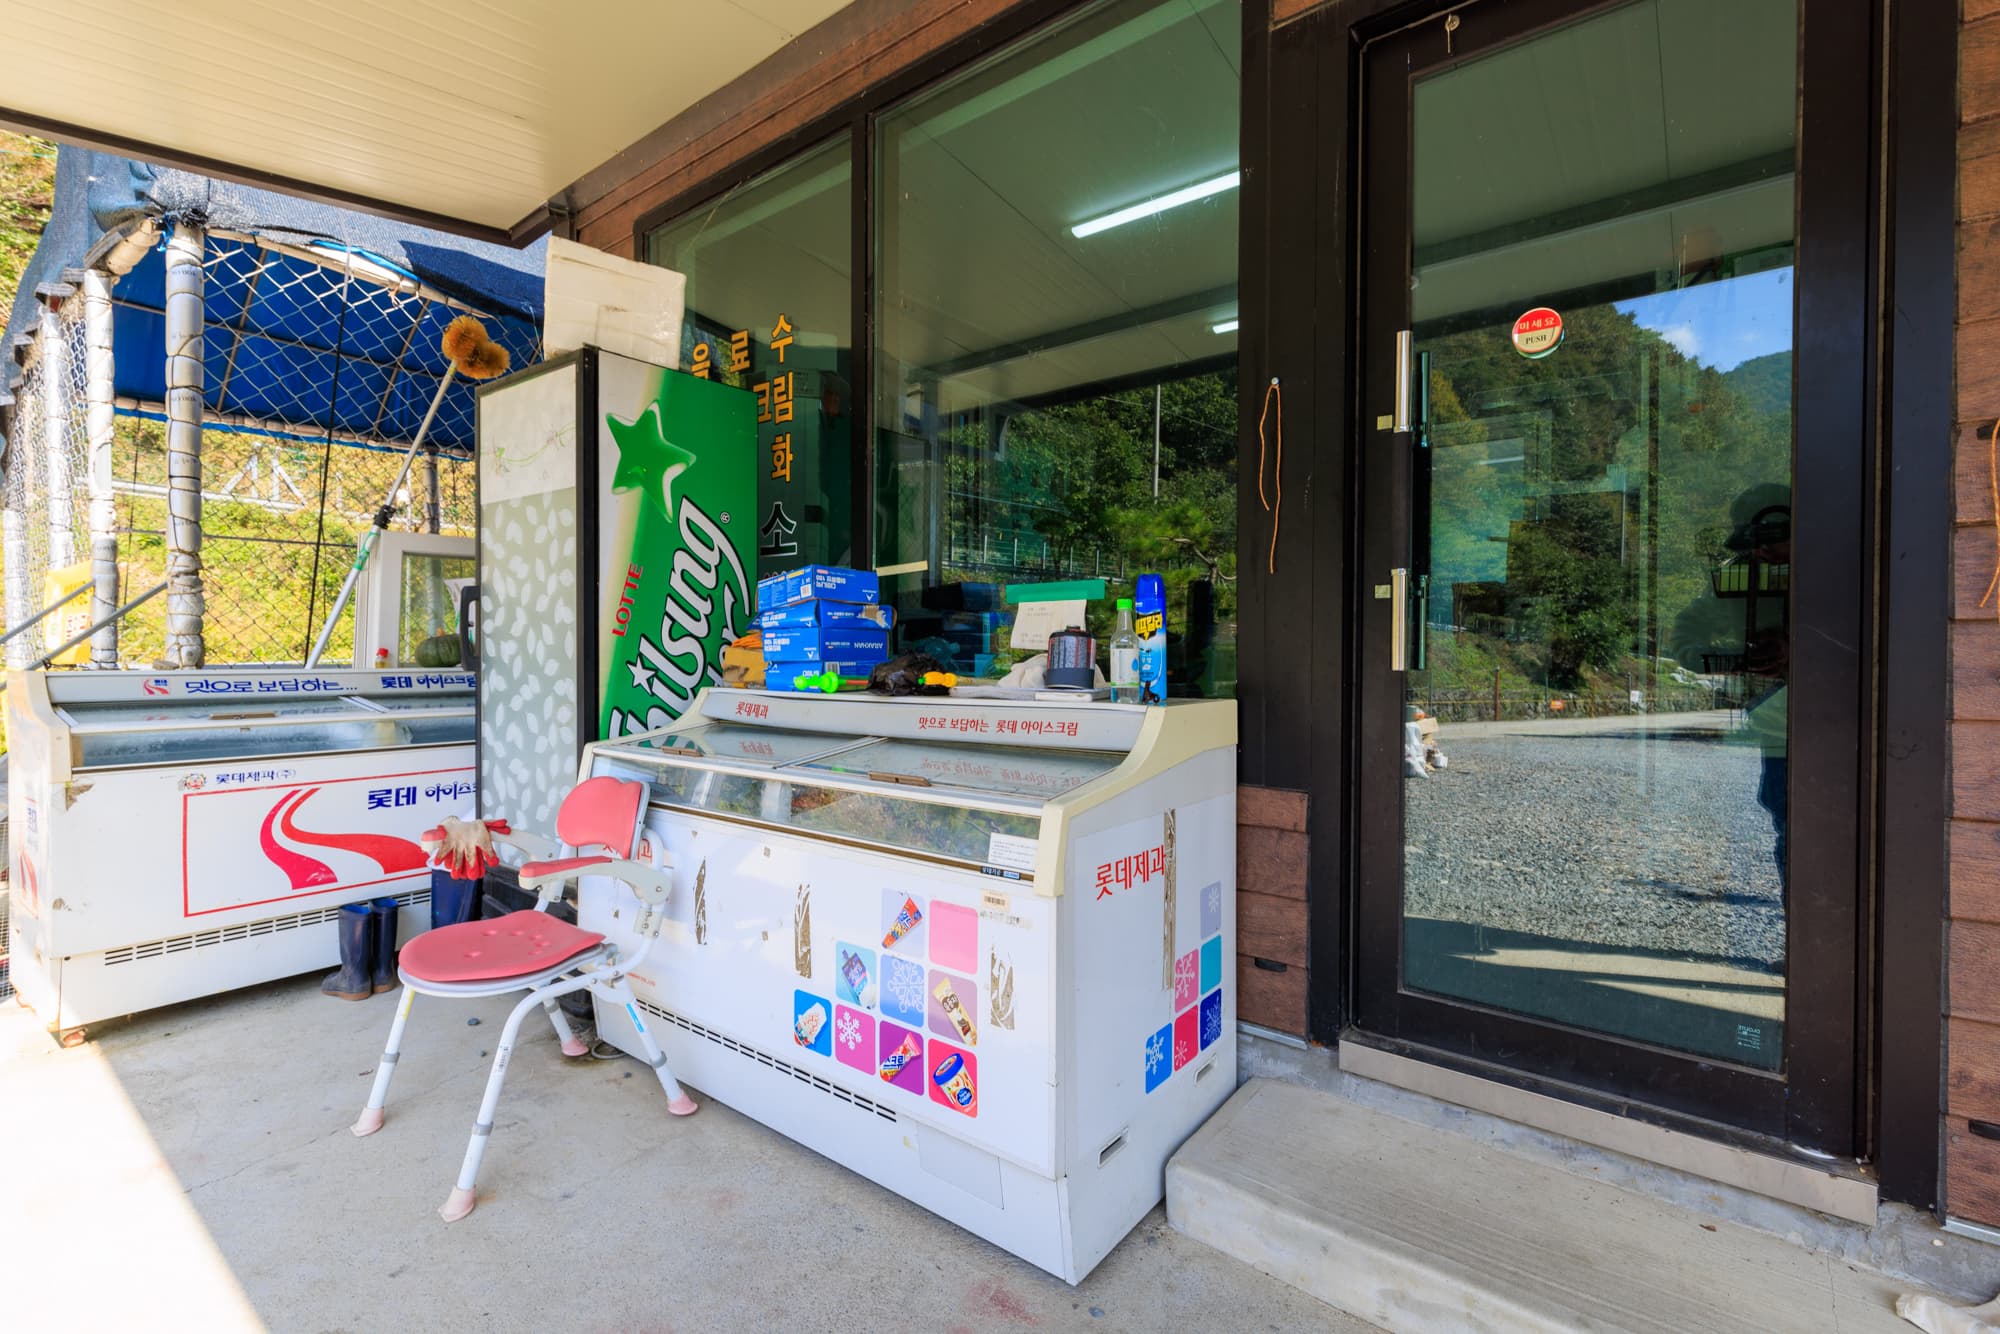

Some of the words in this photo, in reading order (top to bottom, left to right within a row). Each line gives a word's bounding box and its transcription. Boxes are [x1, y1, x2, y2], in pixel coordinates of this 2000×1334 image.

[1519, 317, 1555, 330] 미세요
[1525, 335, 1547, 345] PUSH
[612, 562, 643, 637] LOTTE
[185, 679, 255, 694] 맛으로
[381, 676, 412, 689] 롯데
[735, 701, 769, 719] 롯데제과
[919, 717, 947, 730] 맛으로
[950, 718, 990, 733] 보답하는
[996, 719, 1018, 734] 롯데
[1020, 720, 1079, 736] 아이스크림
[368, 786, 417, 810] 롯데
[425, 781, 477, 802] 아이스
[1095, 844, 1166, 901] 롯데제과
